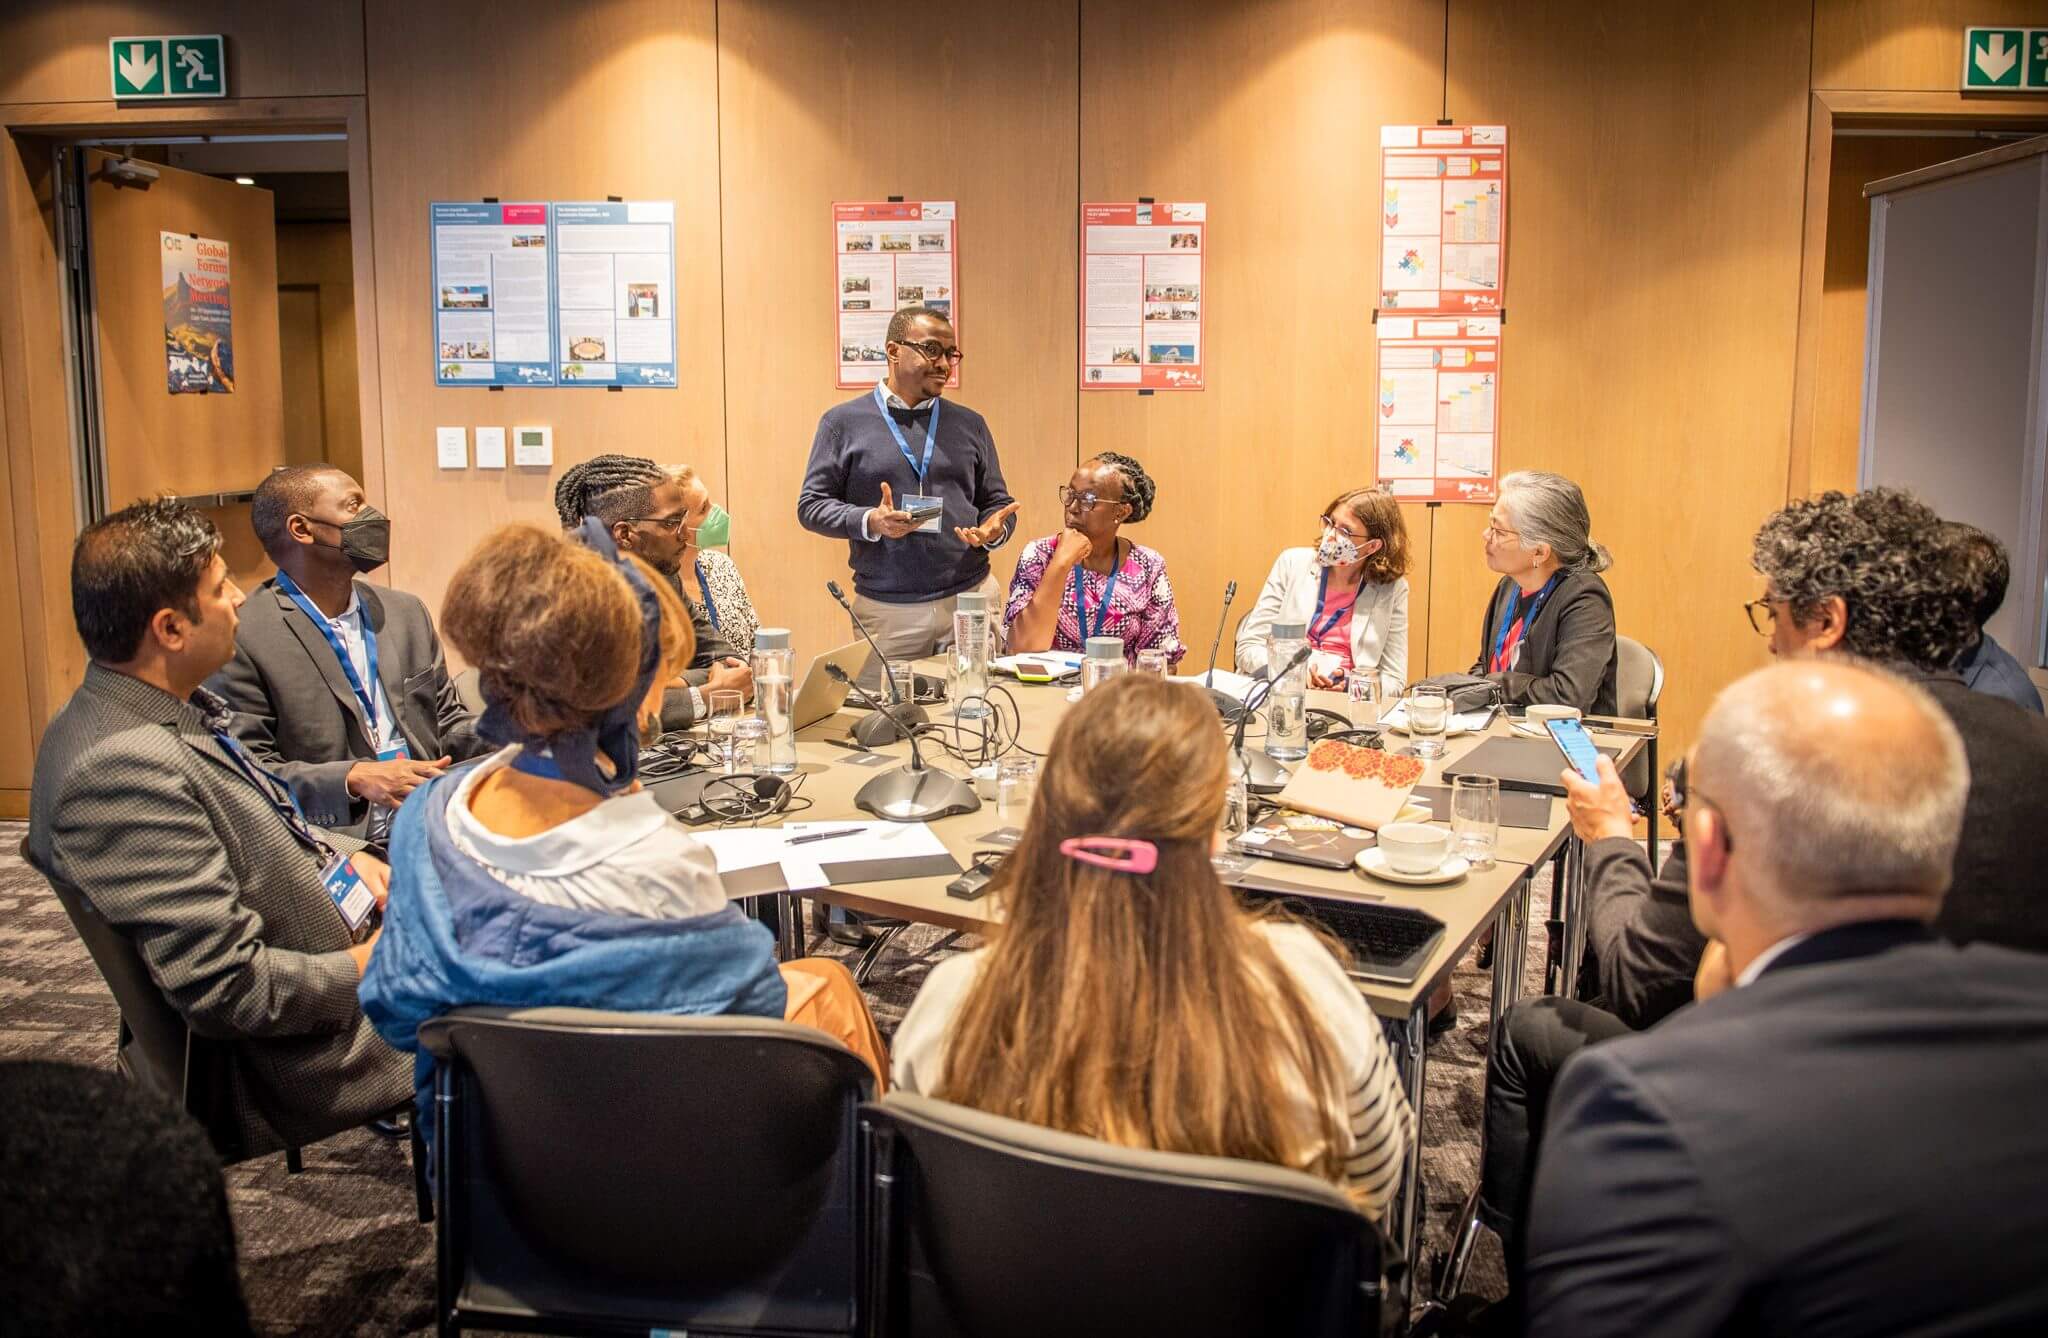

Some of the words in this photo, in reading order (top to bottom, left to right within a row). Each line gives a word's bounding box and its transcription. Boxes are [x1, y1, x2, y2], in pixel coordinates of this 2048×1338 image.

[197, 242, 227, 258] Global
[197, 258, 227, 274] Forum
[189, 273, 228, 289] Network
[190, 289, 229, 309] Meeting
